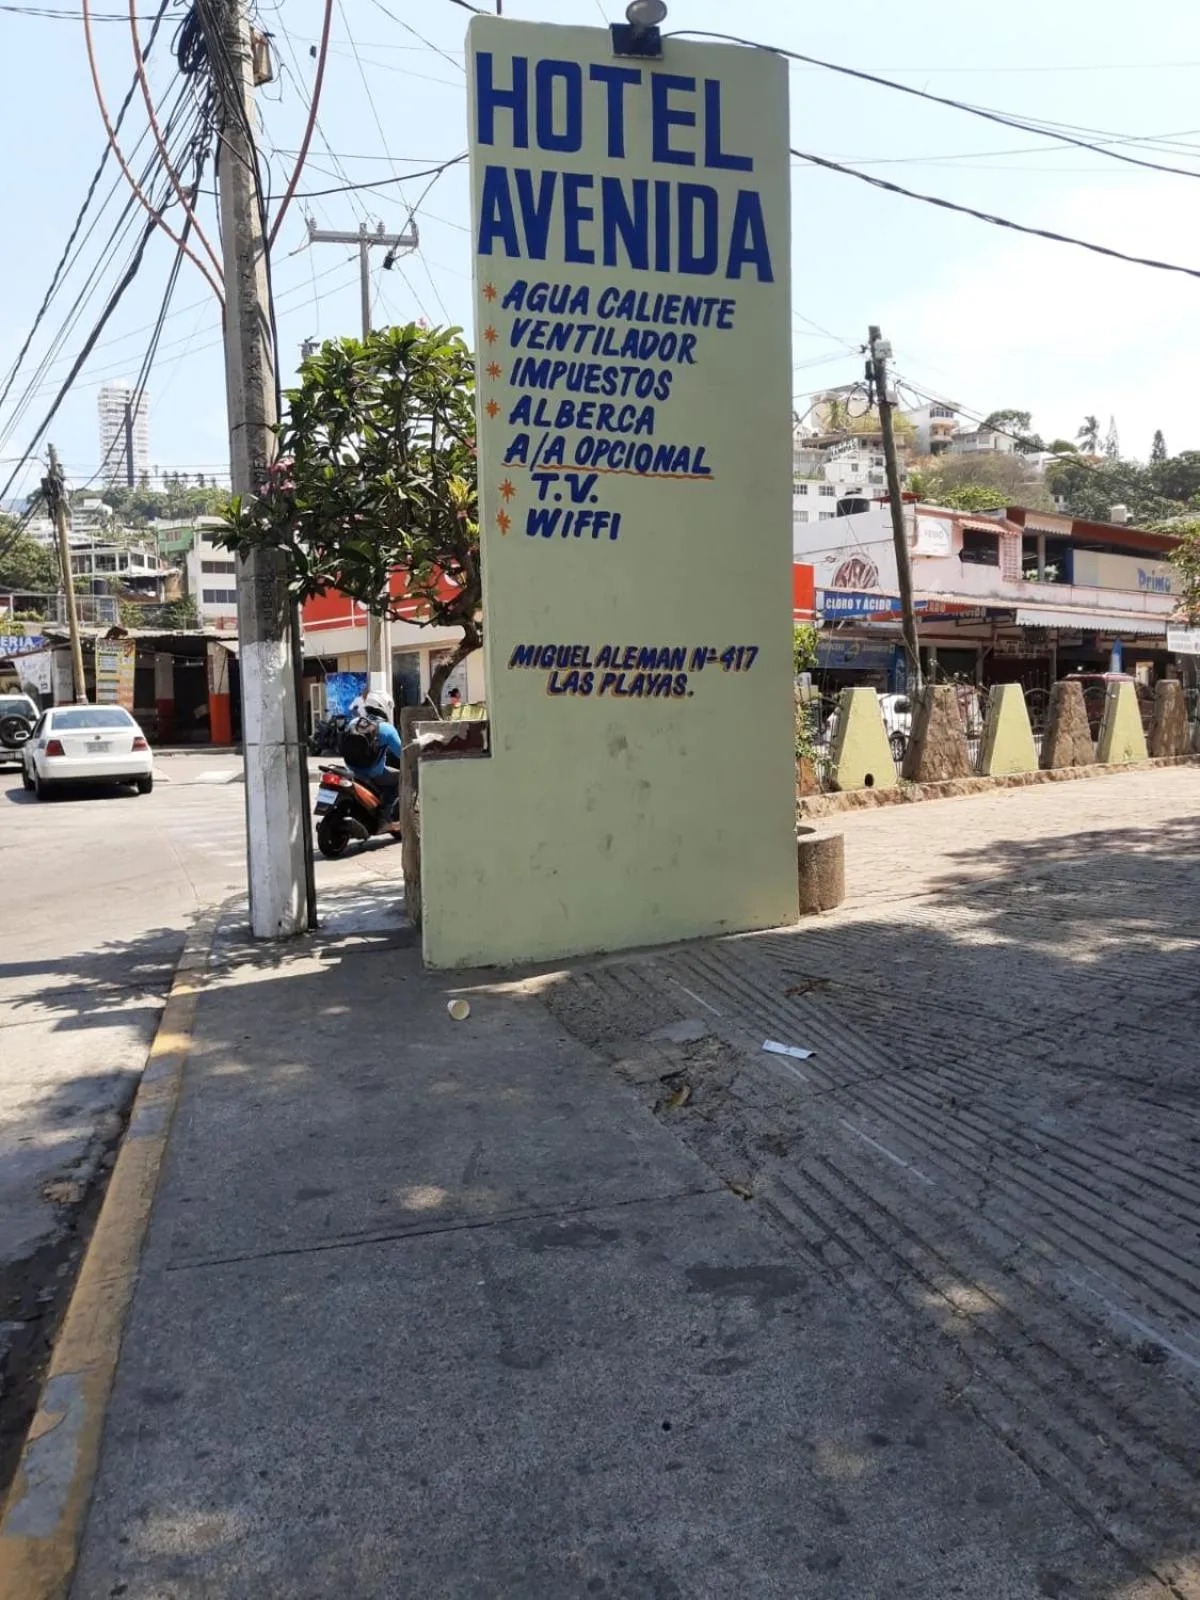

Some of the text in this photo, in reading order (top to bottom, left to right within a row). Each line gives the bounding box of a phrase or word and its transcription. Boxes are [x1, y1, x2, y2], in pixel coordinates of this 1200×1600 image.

[476, 52, 753, 172] HOTEL
[478, 165, 774, 283] AVENIDA
[502, 280, 736, 329] AGUA CALIENTE
[510, 318, 698, 364] VENTILADOR
[510, 357, 673, 401] IMPUESTOS
[509, 395, 655, 435] ALBERCA
[504, 432, 711, 475] A/A OPCIONAL
[531, 473, 599, 503] T.V.
[526, 508, 621, 540] WIFFI
[855, 599, 862, 609] Y
[508, 644, 592, 669] MIGUEL
[595, 646, 686, 671] ALEMAN
[719, 646, 759, 671] 417
[548, 671, 594, 696] LAS
